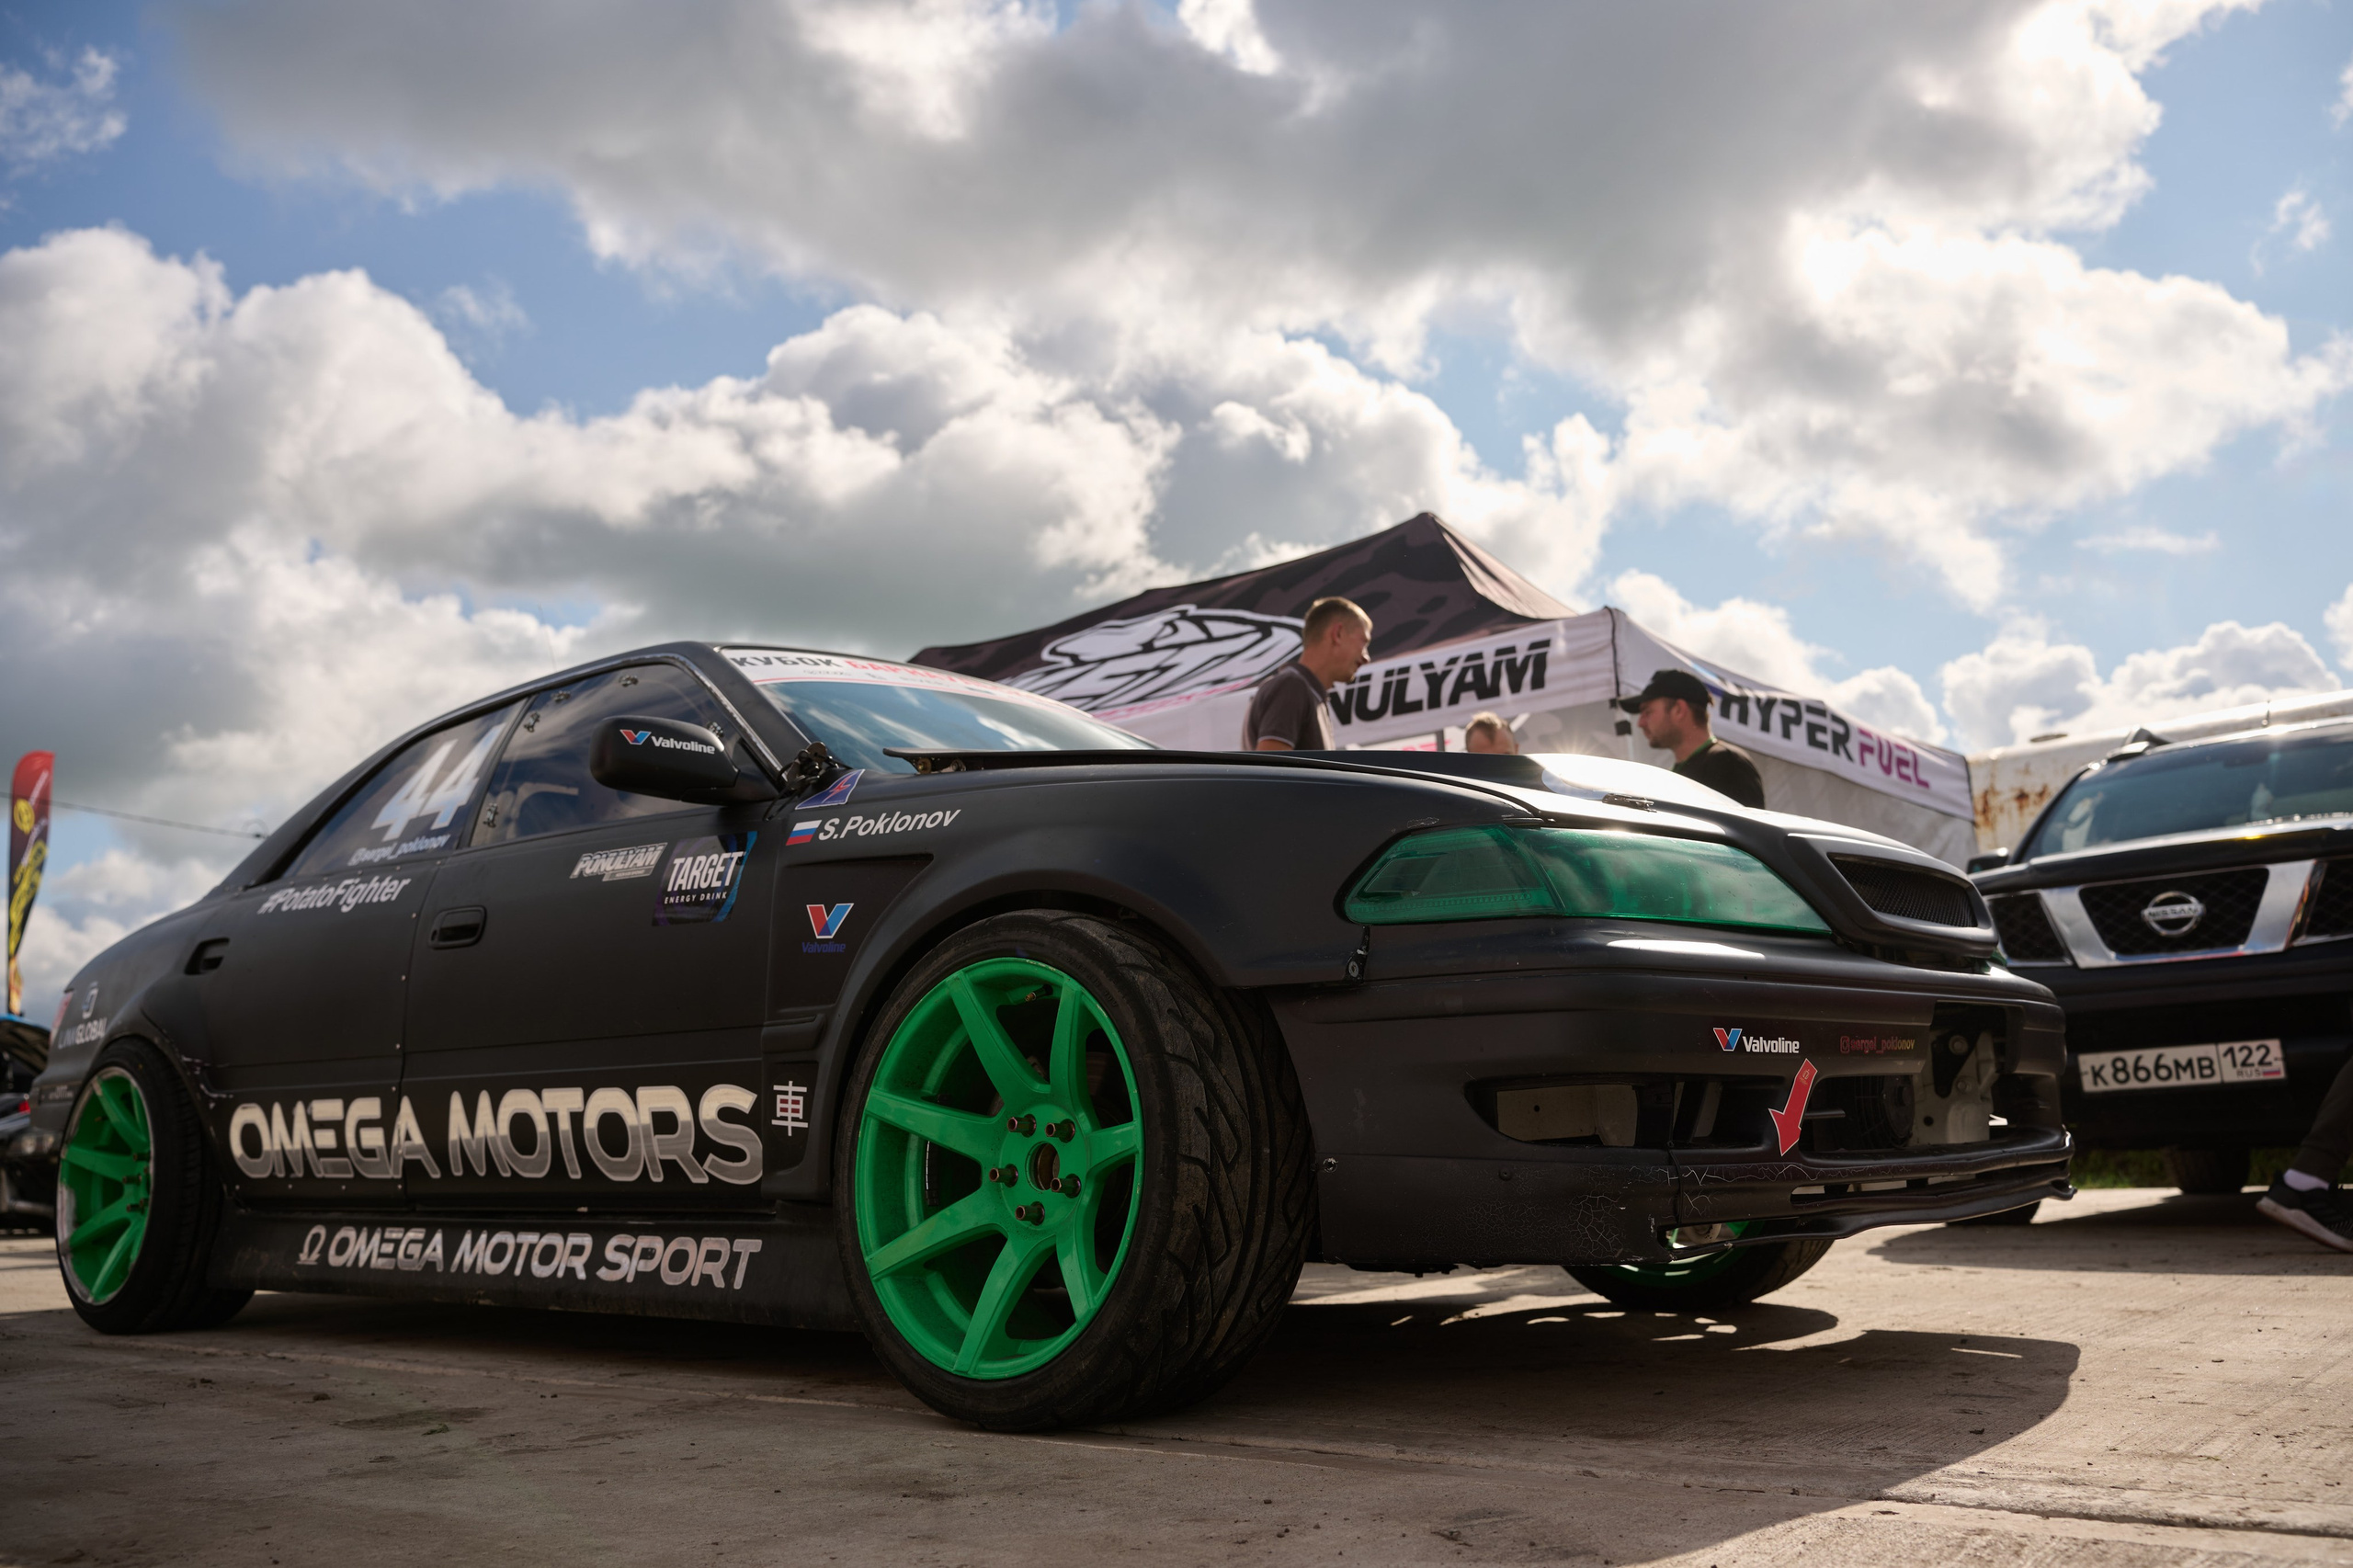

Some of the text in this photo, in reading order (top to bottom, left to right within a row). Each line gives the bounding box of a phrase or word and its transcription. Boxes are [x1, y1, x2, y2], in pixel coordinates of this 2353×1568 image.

[730, 656, 843, 668] КУБОК
[651, 735, 716, 755] Valvoline
[1719, 689, 1930, 789] HYPER FUEL
[370, 722, 506, 843] 44
[818, 809, 962, 841] S.Poklonov
[572, 844, 666, 877] PONULYAM
[666, 851, 746, 892] TARGET
[256, 876, 412, 915] #PotatoFighter
[664, 891, 728, 905] ENERGY DRINK
[2147, 904, 2200, 920] NISSAN
[801, 941, 847, 954] Valvoline
[1743, 1035, 1800, 1054] Valvoline
[2222, 1044, 2272, 1070] 122
[2236, 1068, 2262, 1079] RUS
[771, 1080, 809, 1137] 車
[229, 1084, 764, 1185] OMEGA MOTORS
[327, 1225, 444, 1273] OMEGA
[449, 1229, 594, 1280] MOTOR
[596, 1233, 763, 1290] SPORT
